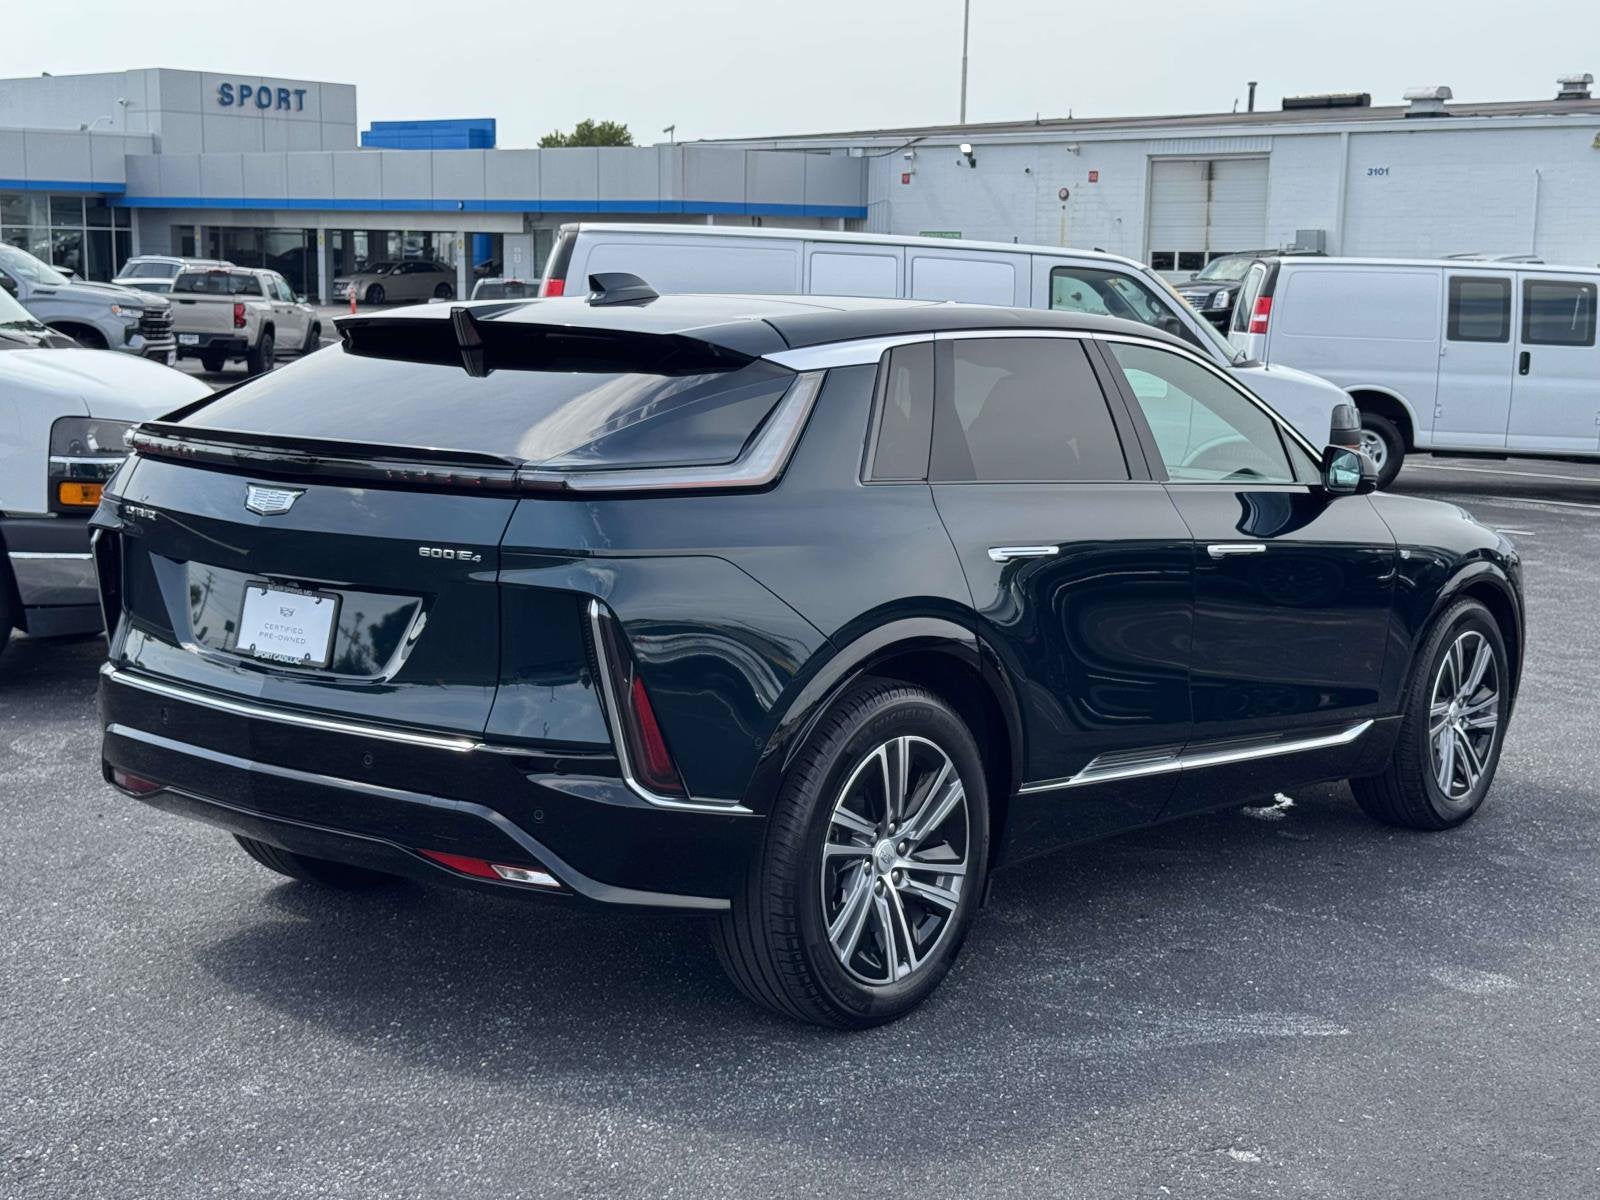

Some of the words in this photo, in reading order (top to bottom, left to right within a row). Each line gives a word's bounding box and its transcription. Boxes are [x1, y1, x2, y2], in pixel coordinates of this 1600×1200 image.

[218, 82, 307, 112] SPORT
[1367, 167, 1389, 177] 3101
[264, 623, 304, 635] CERTIFIED
[258, 632, 306, 645] PRE-OWNED
